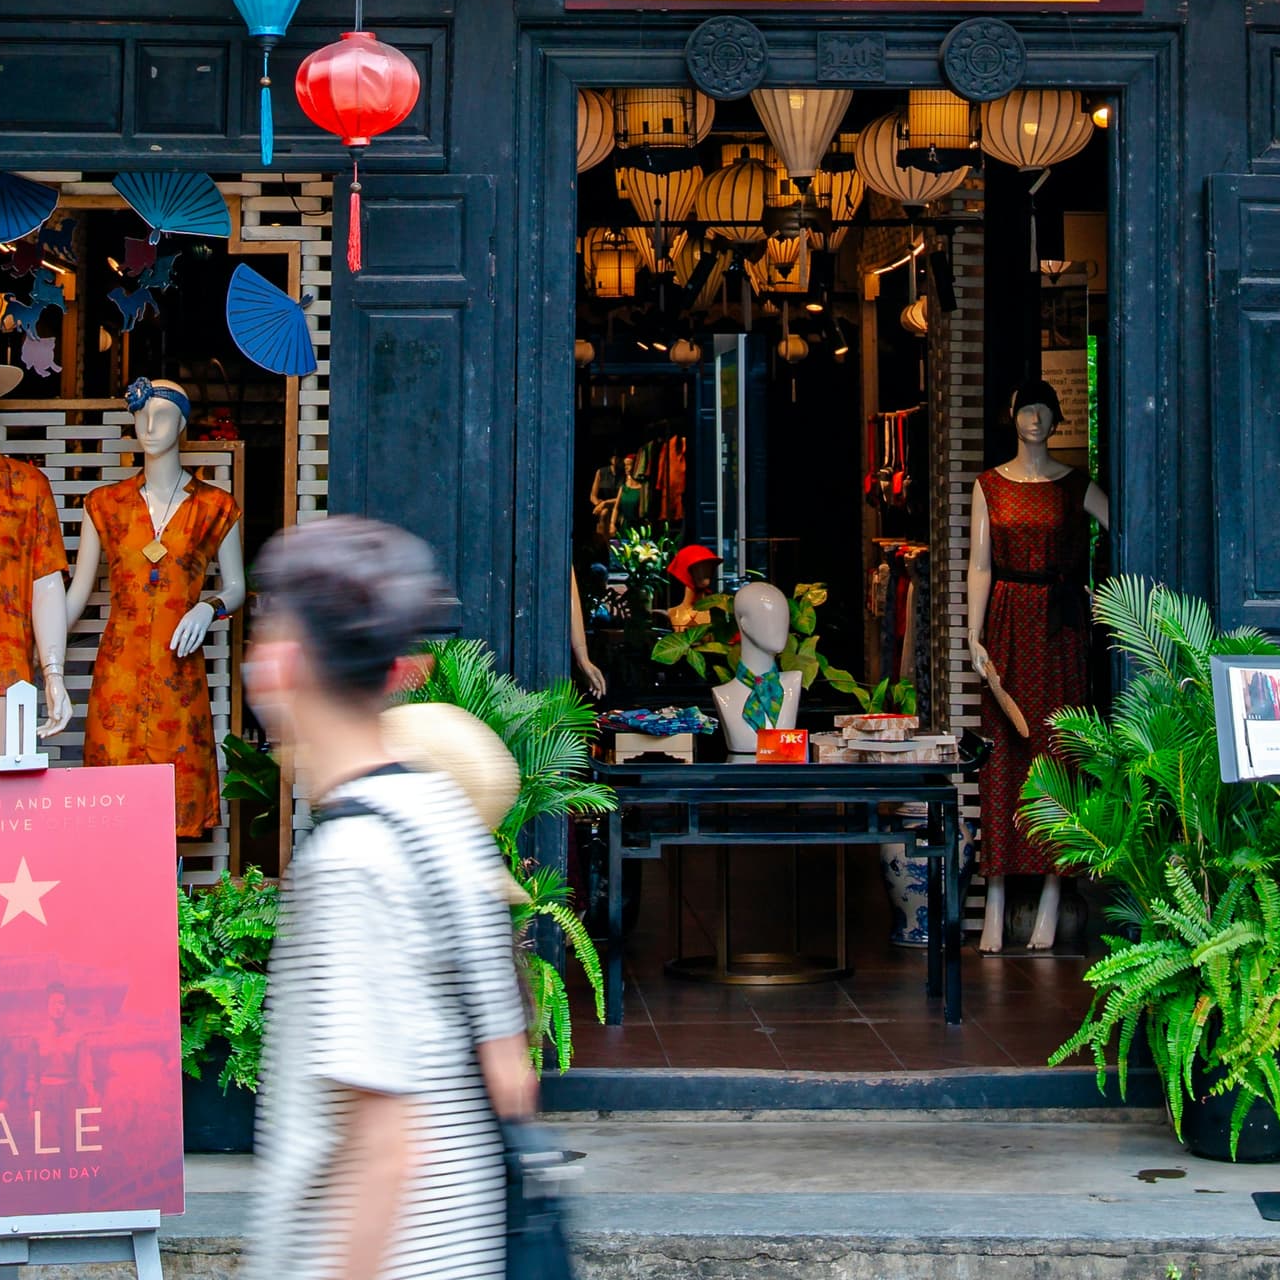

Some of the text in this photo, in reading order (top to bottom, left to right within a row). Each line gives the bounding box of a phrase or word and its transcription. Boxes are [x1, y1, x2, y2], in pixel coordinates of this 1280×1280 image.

[14, 797, 52, 811] AND
[64, 794, 126, 809] ENJOY
[69, 1166, 101, 1179] DAY
